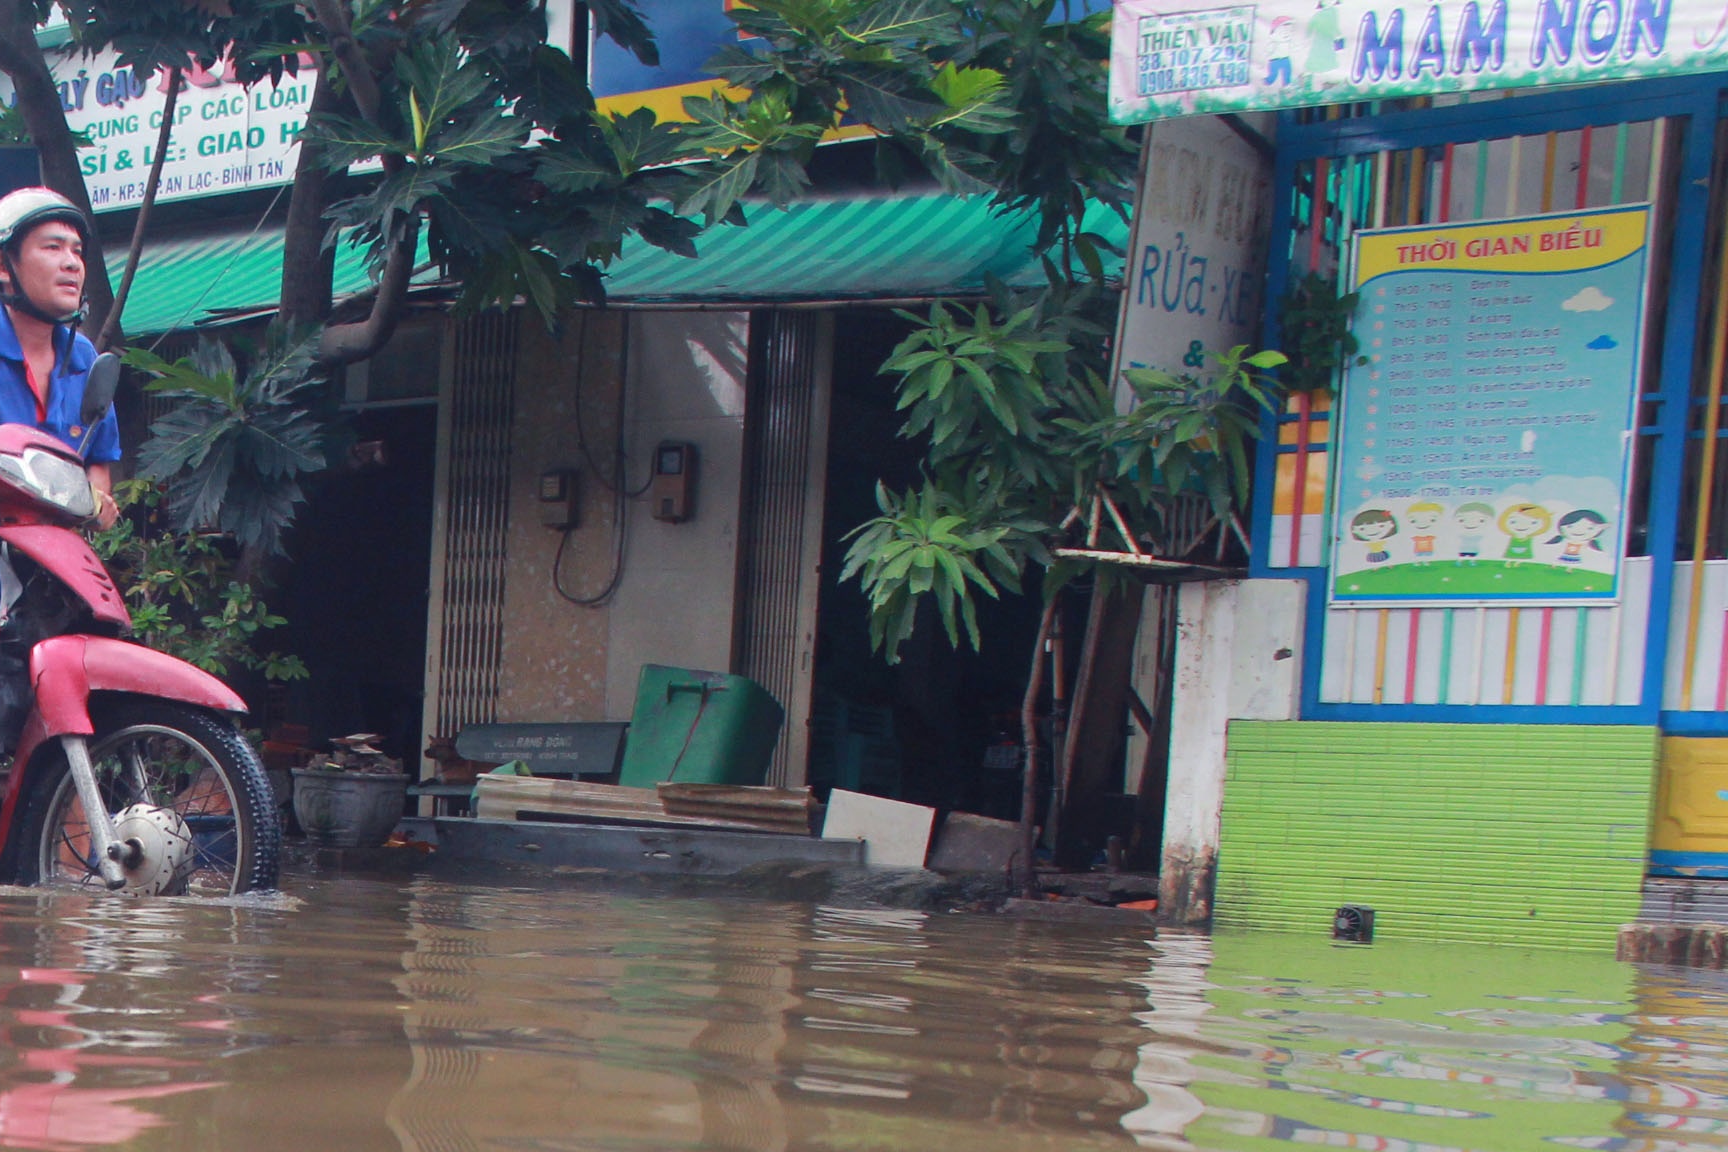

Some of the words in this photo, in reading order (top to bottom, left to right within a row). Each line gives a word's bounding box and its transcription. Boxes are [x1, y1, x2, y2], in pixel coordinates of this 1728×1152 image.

[85, 114, 140, 139] CUNG
[200, 93, 245, 121] CÁC
[255, 85, 308, 112] LOẠI
[197, 126, 266, 158] GIAO
[258, 157, 285, 180] TÂN
[1396, 241, 1457, 264] THỜI
[1465, 235, 1530, 258] GIAN
[1538, 219, 1603, 253] BIỂU
